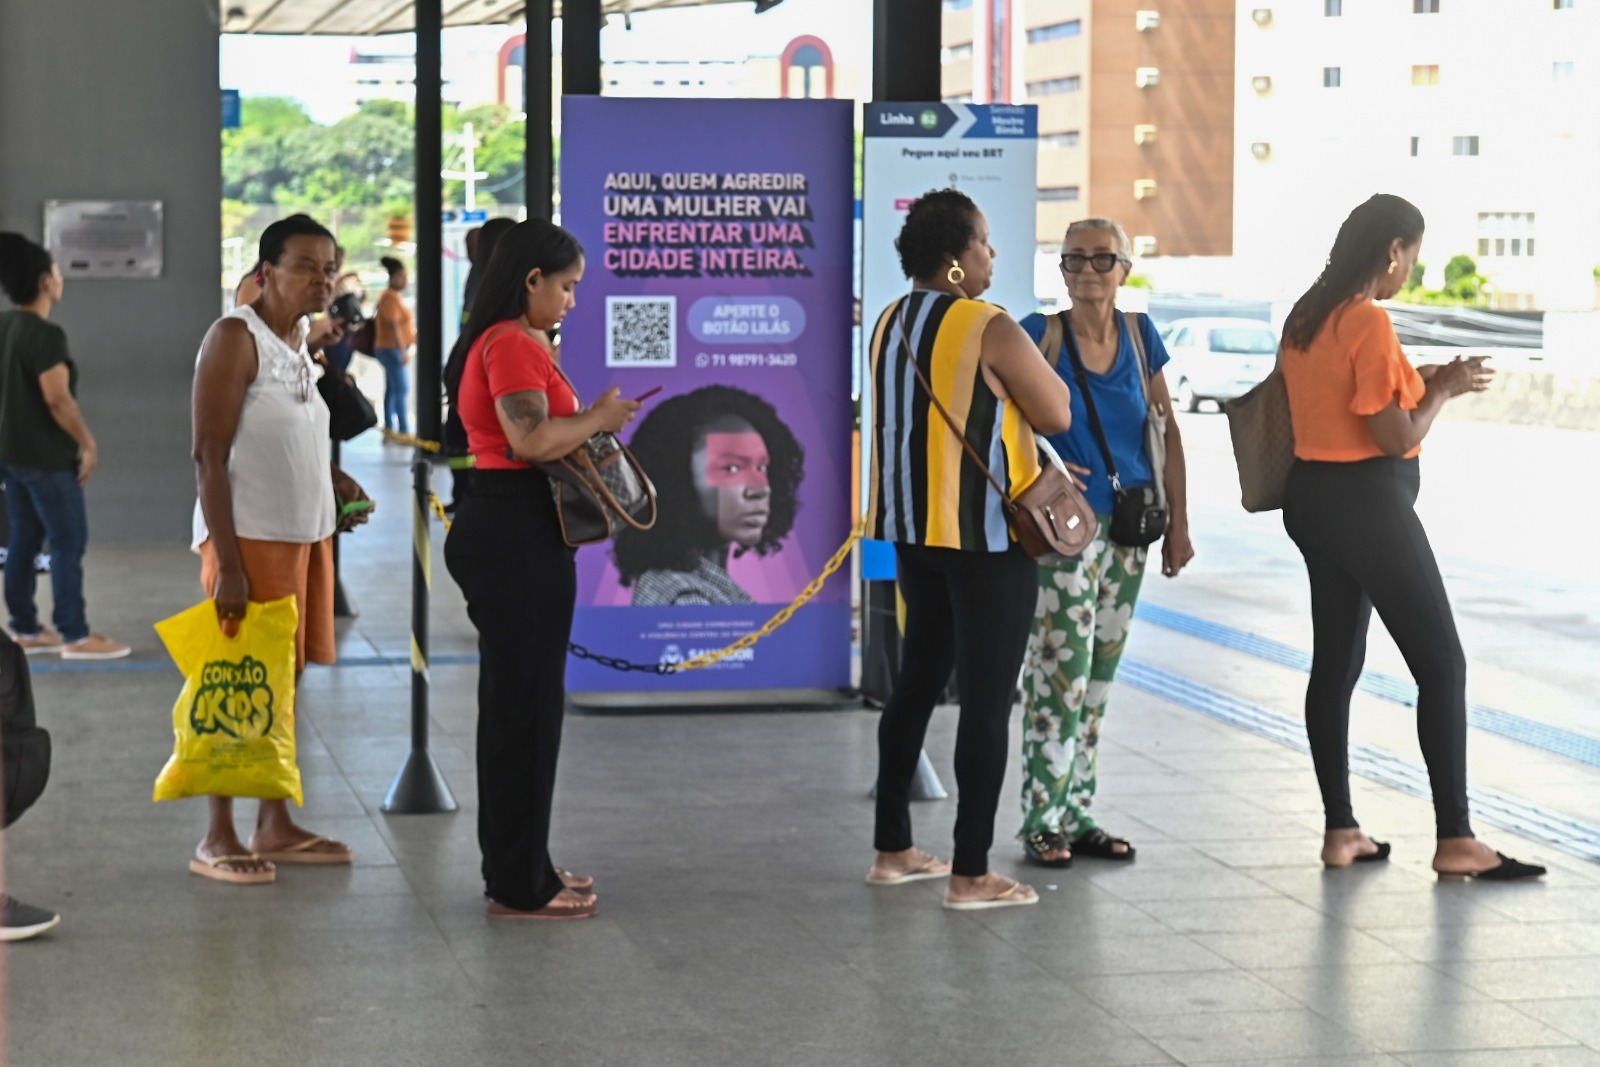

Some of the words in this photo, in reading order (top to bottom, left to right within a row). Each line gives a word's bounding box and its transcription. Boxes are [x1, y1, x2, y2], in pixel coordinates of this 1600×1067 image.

[880, 113, 914, 125] Linha
[902, 148, 934, 160] Pegue
[937, 148, 959, 160] aqui
[962, 150, 980, 158] seu
[982, 148, 1004, 158] BRT
[604, 172, 657, 192] AQUI,
[661, 172, 716, 190] QUEM
[721, 173, 806, 190] AGREDIR
[603, 195, 657, 216] UMA
[663, 195, 761, 216] MULHER
[767, 196, 806, 216] VAI
[603, 222, 743, 244] ENFRENTAR
[750, 222, 805, 243] UMA
[603, 248, 694, 270] CIDADE
[701, 248, 805, 270] INTEIRA.
[713, 304, 766, 319] APERTE
[768, 304, 780, 319] O
[702, 318, 749, 335] BOTÃO
[750, 318, 791, 335] LILÁS
[711, 353, 726, 367] 71
